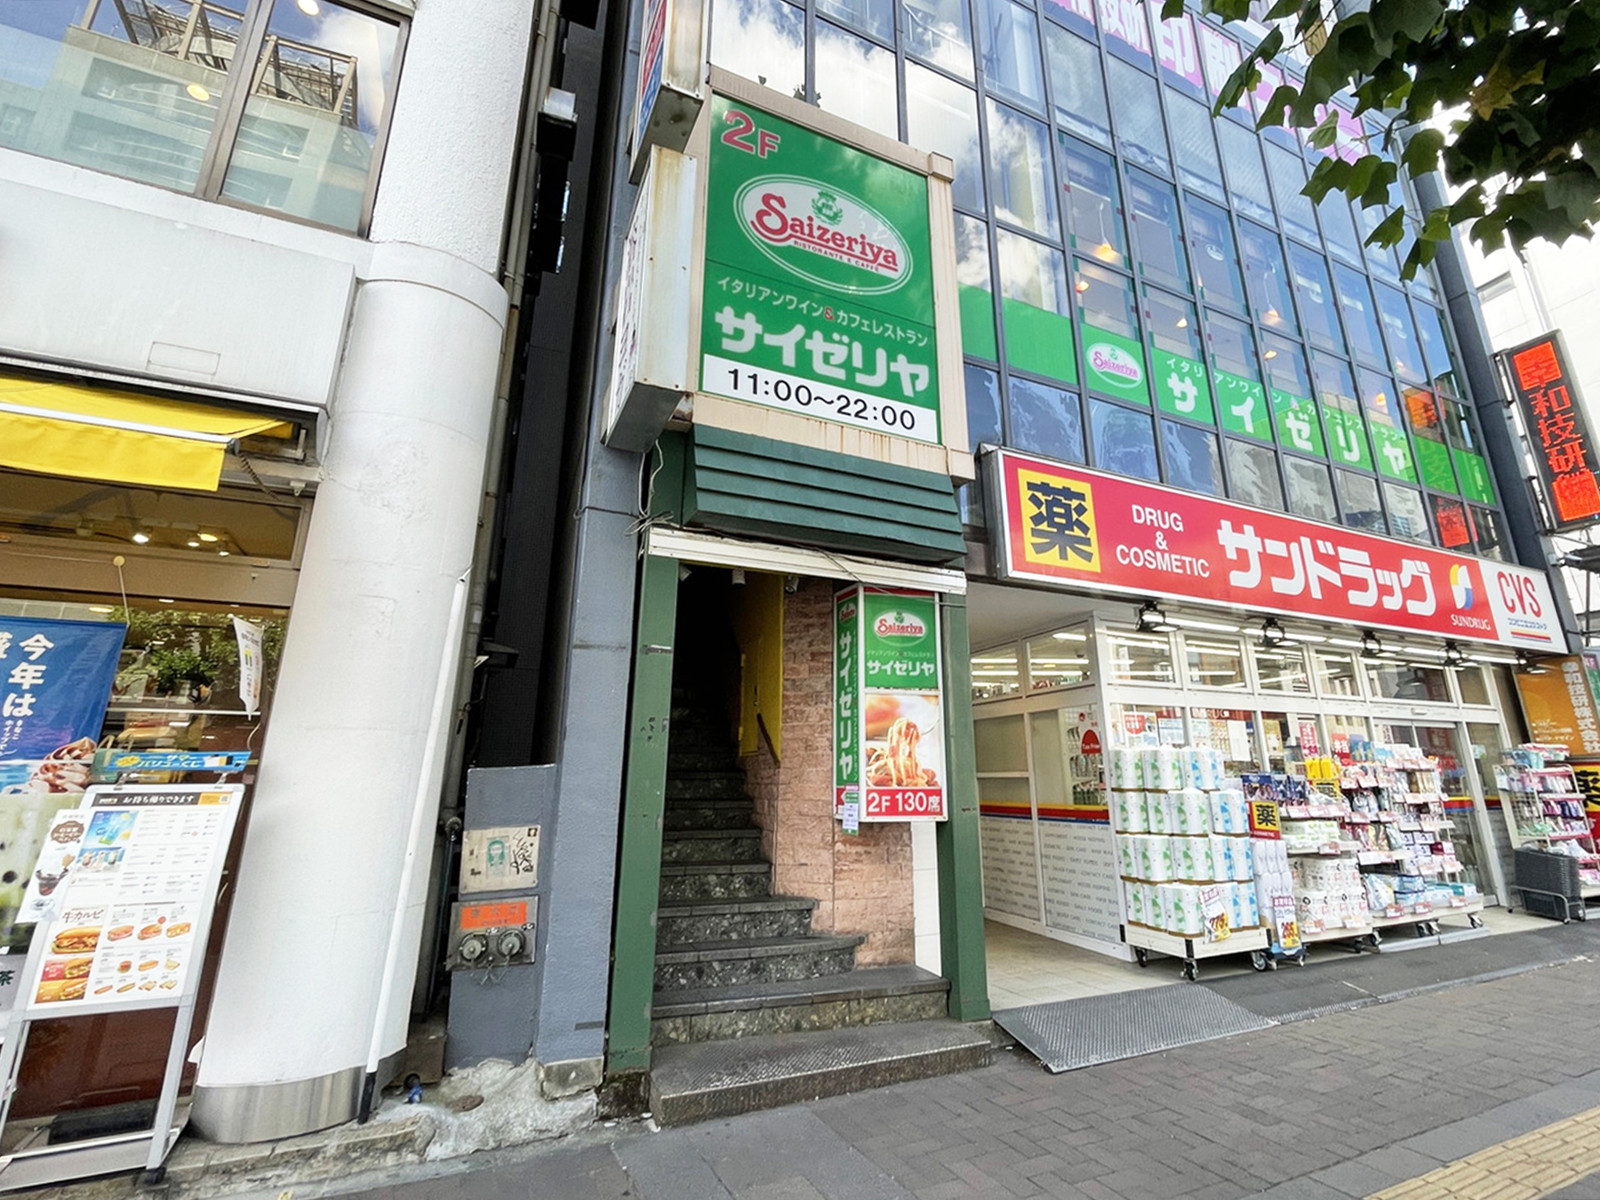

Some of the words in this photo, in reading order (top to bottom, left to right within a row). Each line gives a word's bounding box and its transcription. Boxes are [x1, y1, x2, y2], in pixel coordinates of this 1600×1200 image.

[721, 110, 781, 159] 2F
[750, 193, 899, 272] Saizeriya
[793, 241, 843, 260] RISTORANTE
[717, 276, 928, 347] イタリアンワイン&カフェレストラン
[714, 305, 930, 398] サイゼリヤ
[1027, 481, 1094, 563] 薬
[1131, 504, 1184, 532] DRUG
[1116, 544, 1210, 578] COSMETIC
[1155, 531, 1168, 550] &
[1216, 519, 1437, 616] サンドラッグ
[1496, 569, 1542, 618] CVS
[1450, 613, 1491, 631] SUNDRUG
[3, 633, 55, 718] 今年は
[866, 659, 935, 677] サイゼリヤ
[839, 630, 853, 780] サイゼリヤ
[123, 795, 194, 804] お持ち帰りできます
[867, 792, 891, 813] 2F
[1255, 804, 1277, 827] 薬
